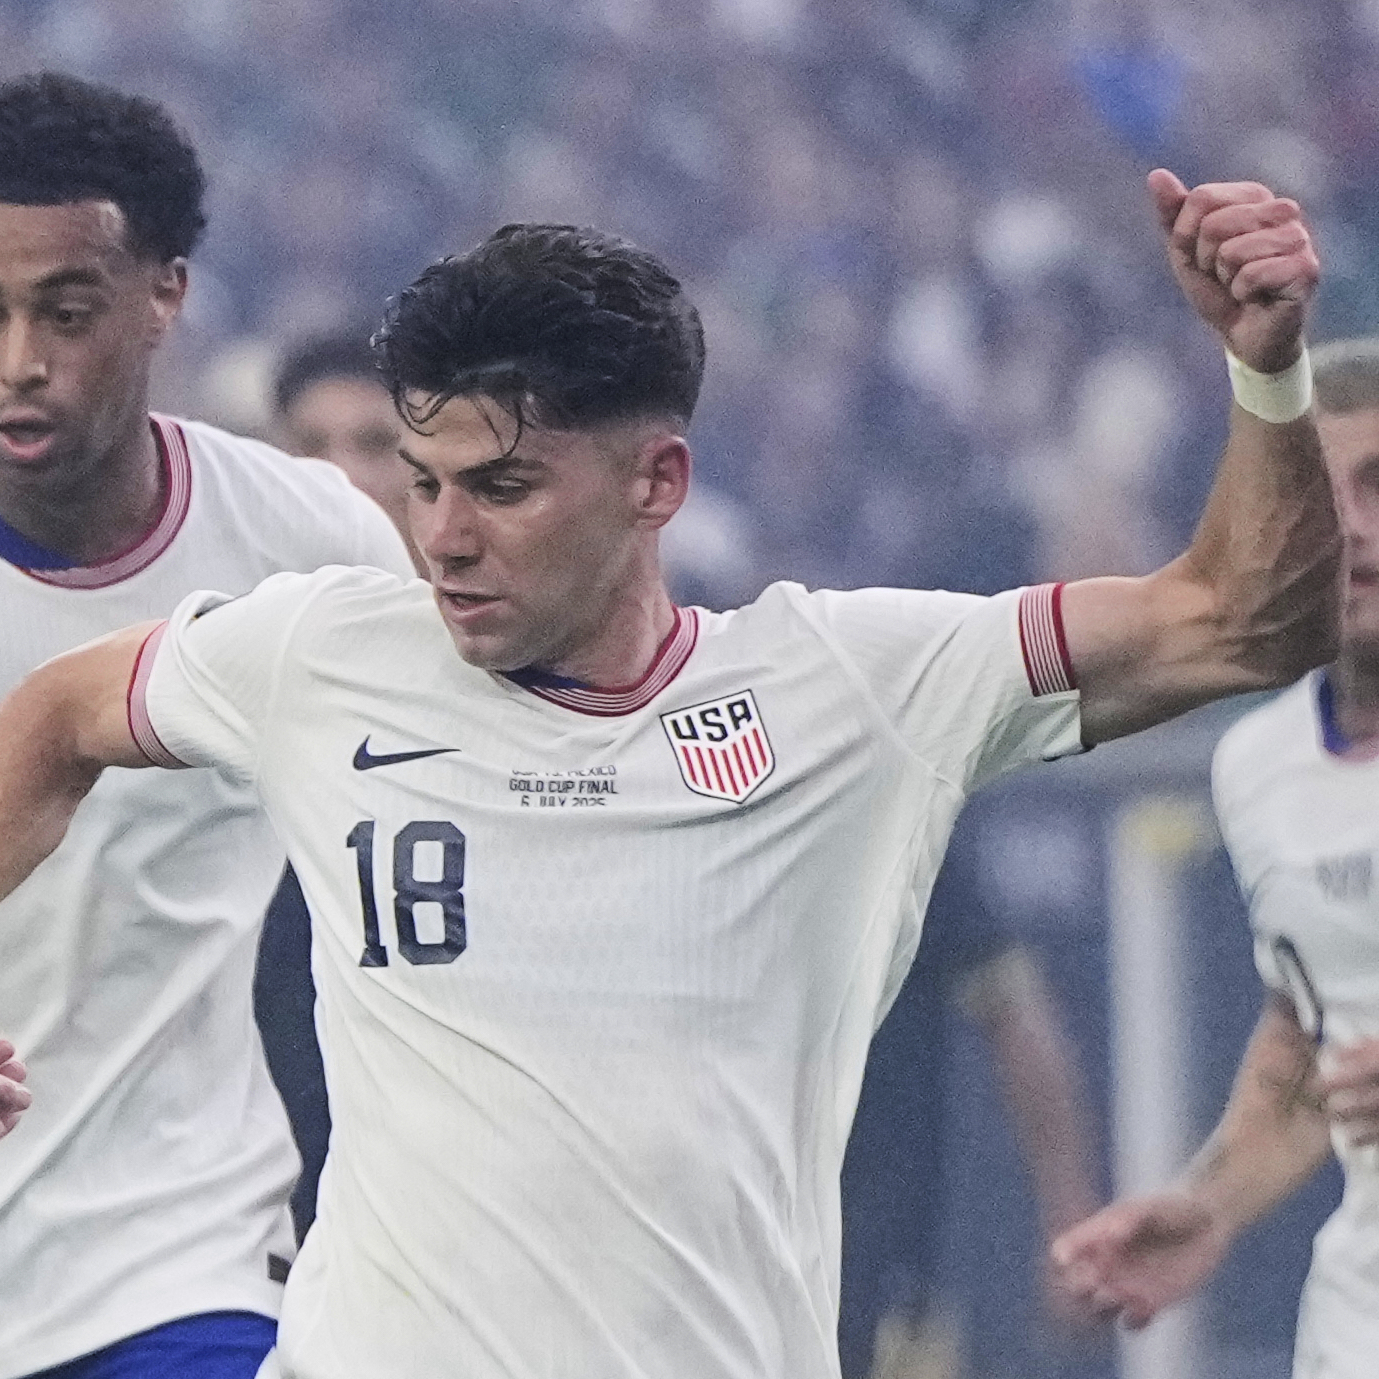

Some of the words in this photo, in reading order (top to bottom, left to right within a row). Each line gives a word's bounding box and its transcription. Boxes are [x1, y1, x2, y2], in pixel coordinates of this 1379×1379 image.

[670, 698, 752, 742] USA
[509, 778, 544, 793] GOLD
[548, 780, 575, 794] CUP
[579, 780, 619, 795] FINAL
[346, 820, 467, 968] 18
